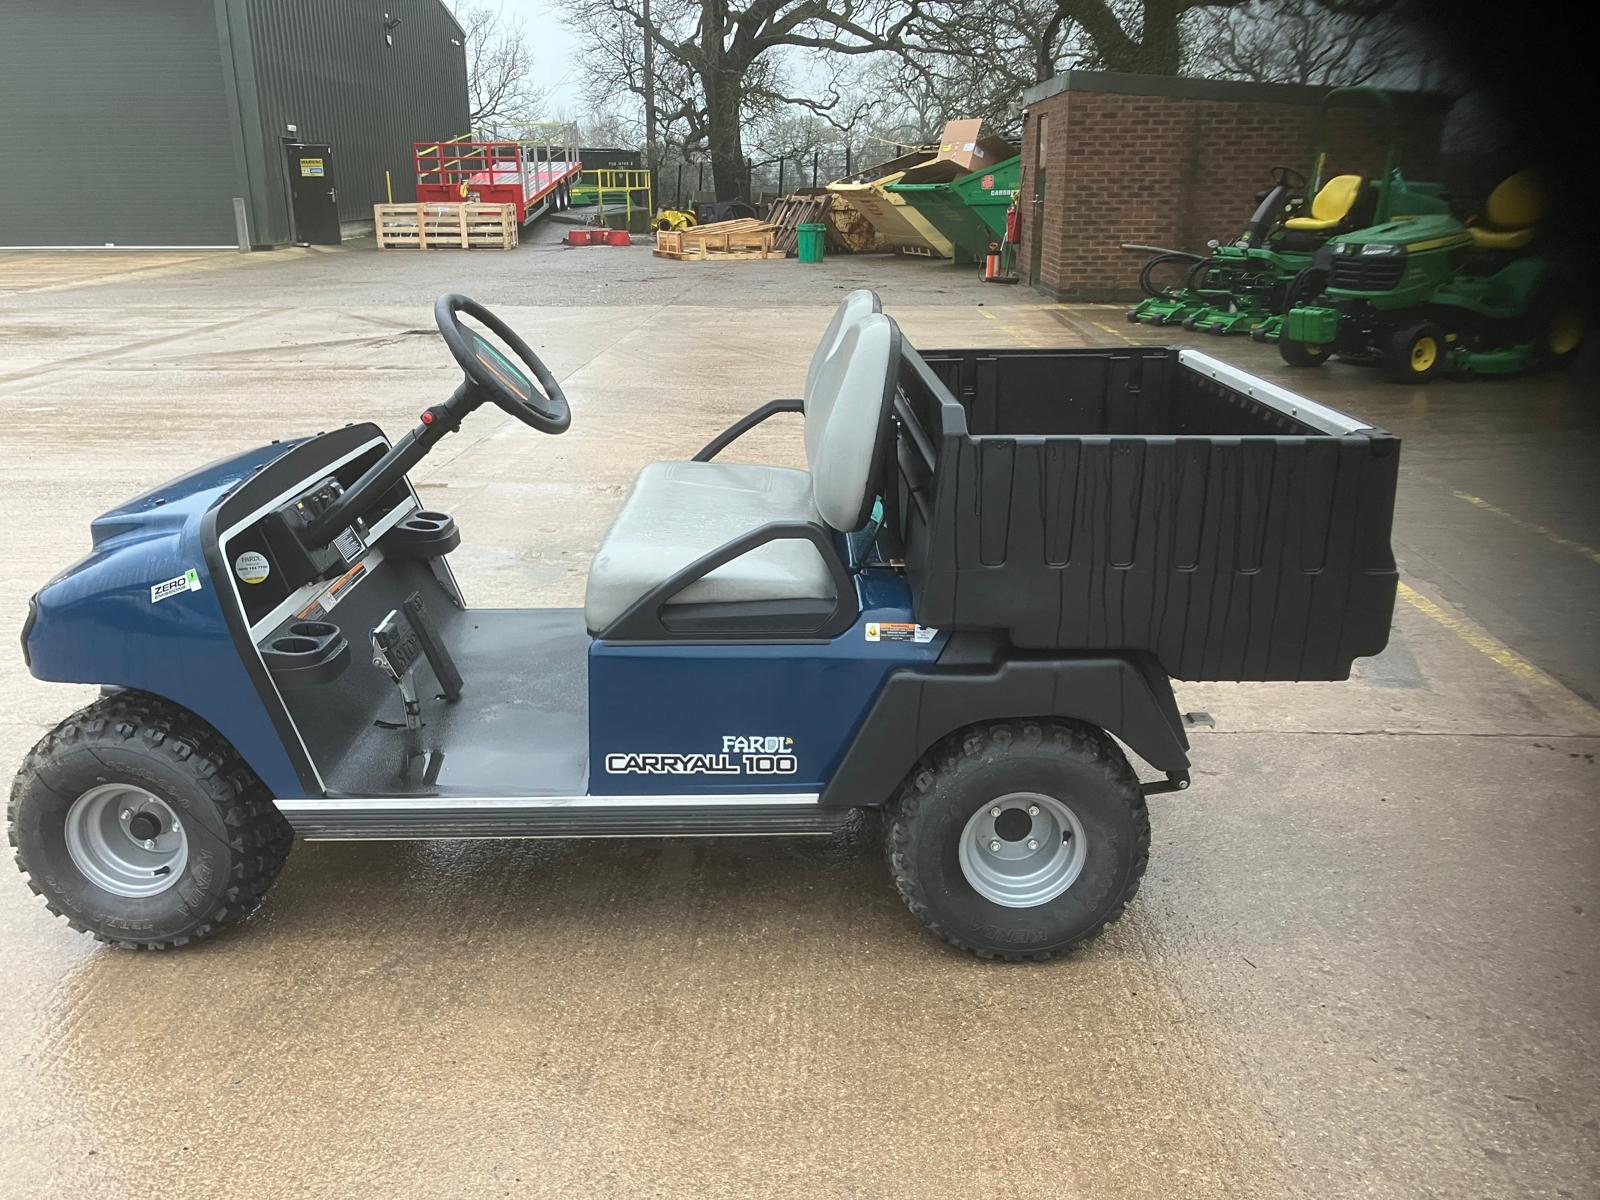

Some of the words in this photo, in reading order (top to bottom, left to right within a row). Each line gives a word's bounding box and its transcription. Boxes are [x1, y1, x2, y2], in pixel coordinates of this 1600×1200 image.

[154, 577, 186, 595] ZERO
[722, 736, 792, 753] FAROL
[606, 753, 740, 774] CARRYALL
[743, 754, 797, 774] 100
